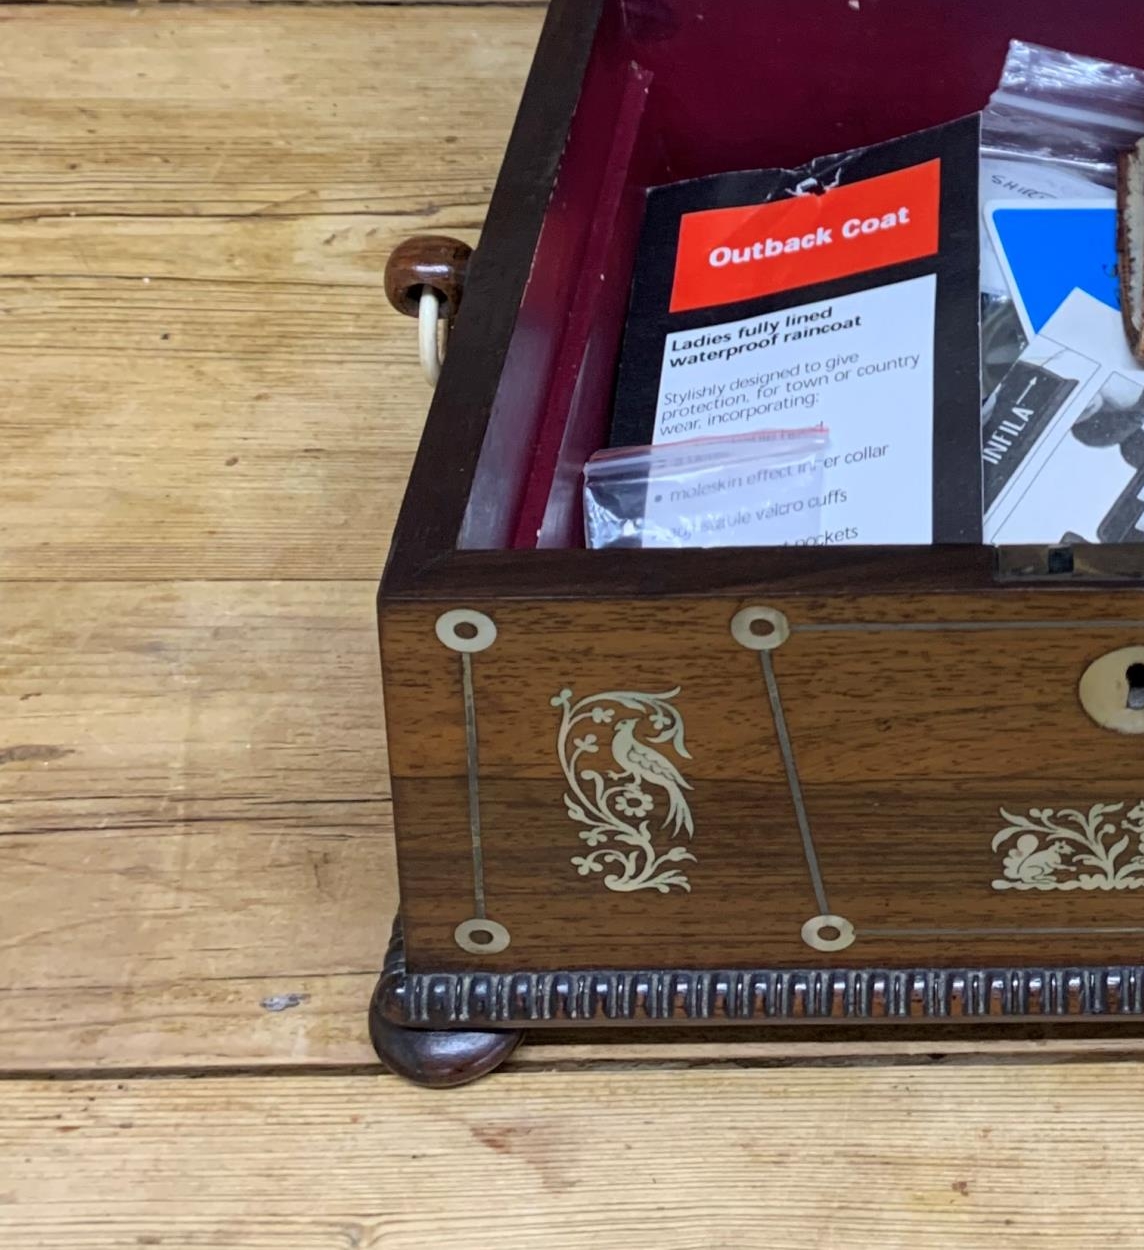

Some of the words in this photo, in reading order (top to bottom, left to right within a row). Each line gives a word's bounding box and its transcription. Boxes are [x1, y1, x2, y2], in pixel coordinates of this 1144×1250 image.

[709, 227, 832, 267] Outback
[841, 206, 910, 239] Coat
[669, 335, 777, 368] waterproof
[784, 315, 862, 342] raincoat
[671, 334, 731, 352] Ladies
[738, 321, 779, 339] fully
[785, 307, 832, 328] lined
[664, 383, 726, 406] Stylishly
[730, 363, 800, 390] designed
[804, 361, 821, 375] to
[825, 353, 859, 372] give
[756, 384, 781, 399] for
[786, 373, 829, 393] town
[834, 370, 850, 382] or
[856, 354, 920, 378] country
[707, 392, 819, 426] incorporating:
[982, 406, 1034, 464] INFILA
[670, 475, 743, 502] moleskin
[746, 465, 792, 486] effect
[844, 444, 889, 464] collar
[807, 488, 847, 509] cuffs
